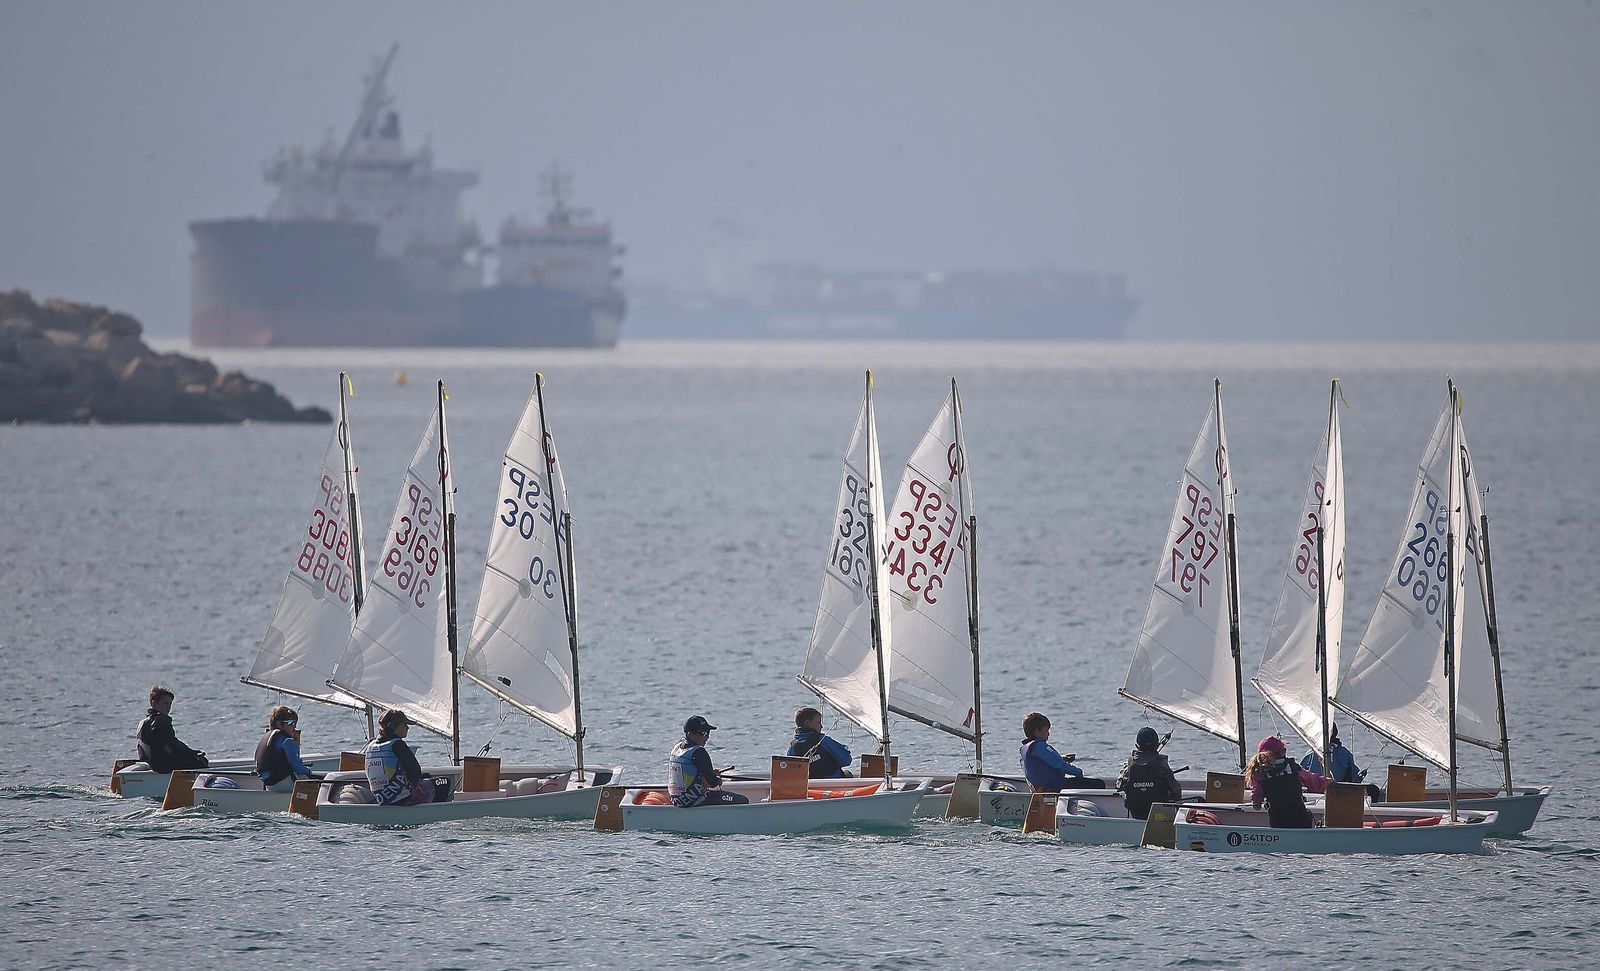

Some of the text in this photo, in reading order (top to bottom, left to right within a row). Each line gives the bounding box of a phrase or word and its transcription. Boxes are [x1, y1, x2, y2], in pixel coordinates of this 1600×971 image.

[395, 516, 440, 577] 3169
[500, 498, 535, 540] 30
[894, 511, 955, 576] 3341
[1174, 515, 1219, 570] 797
